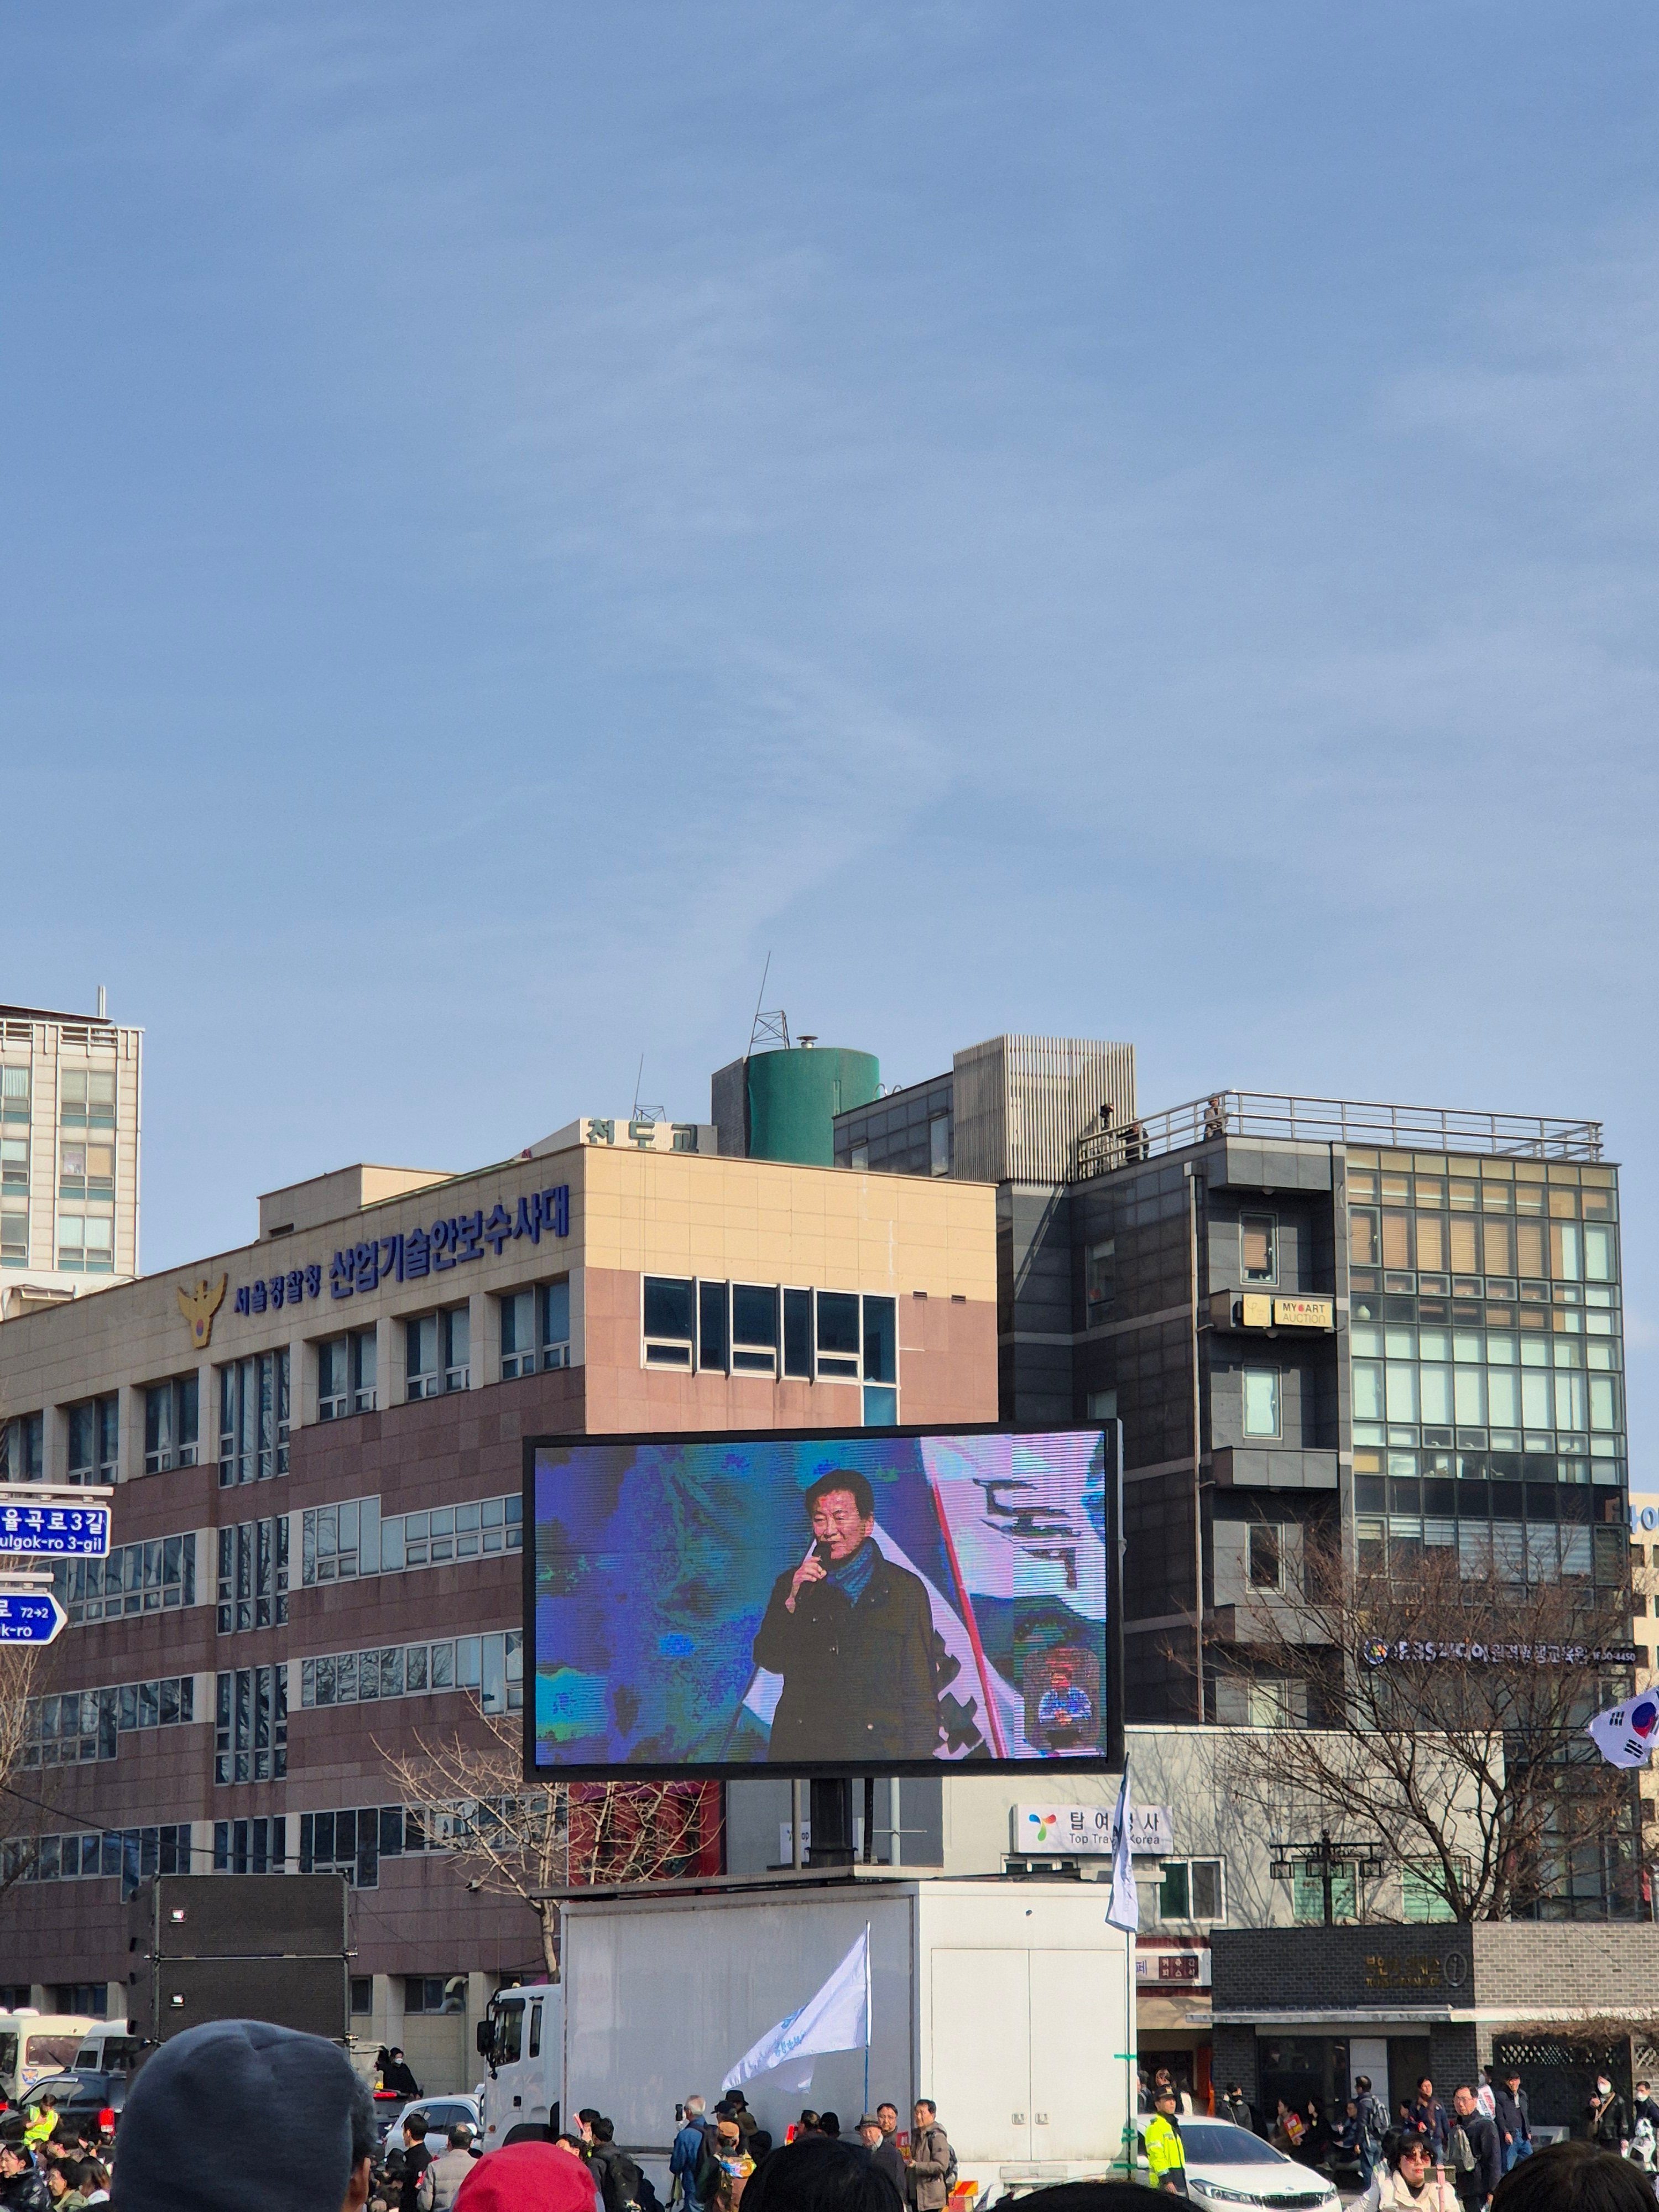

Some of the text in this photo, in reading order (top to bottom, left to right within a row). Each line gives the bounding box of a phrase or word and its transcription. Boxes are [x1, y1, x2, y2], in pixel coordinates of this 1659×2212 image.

[234, 1185, 570, 1317] 서울경찰청 산업기술안보수사대
[1282, 1302, 1325, 1313] MY ART
[1282, 1313, 1326, 1323] AUCTION
[67, 1536, 102, 1553] 3-gil
[1070, 1812, 1159, 1832] 탑여사
[1070, 1833, 1088, 1844] Top
